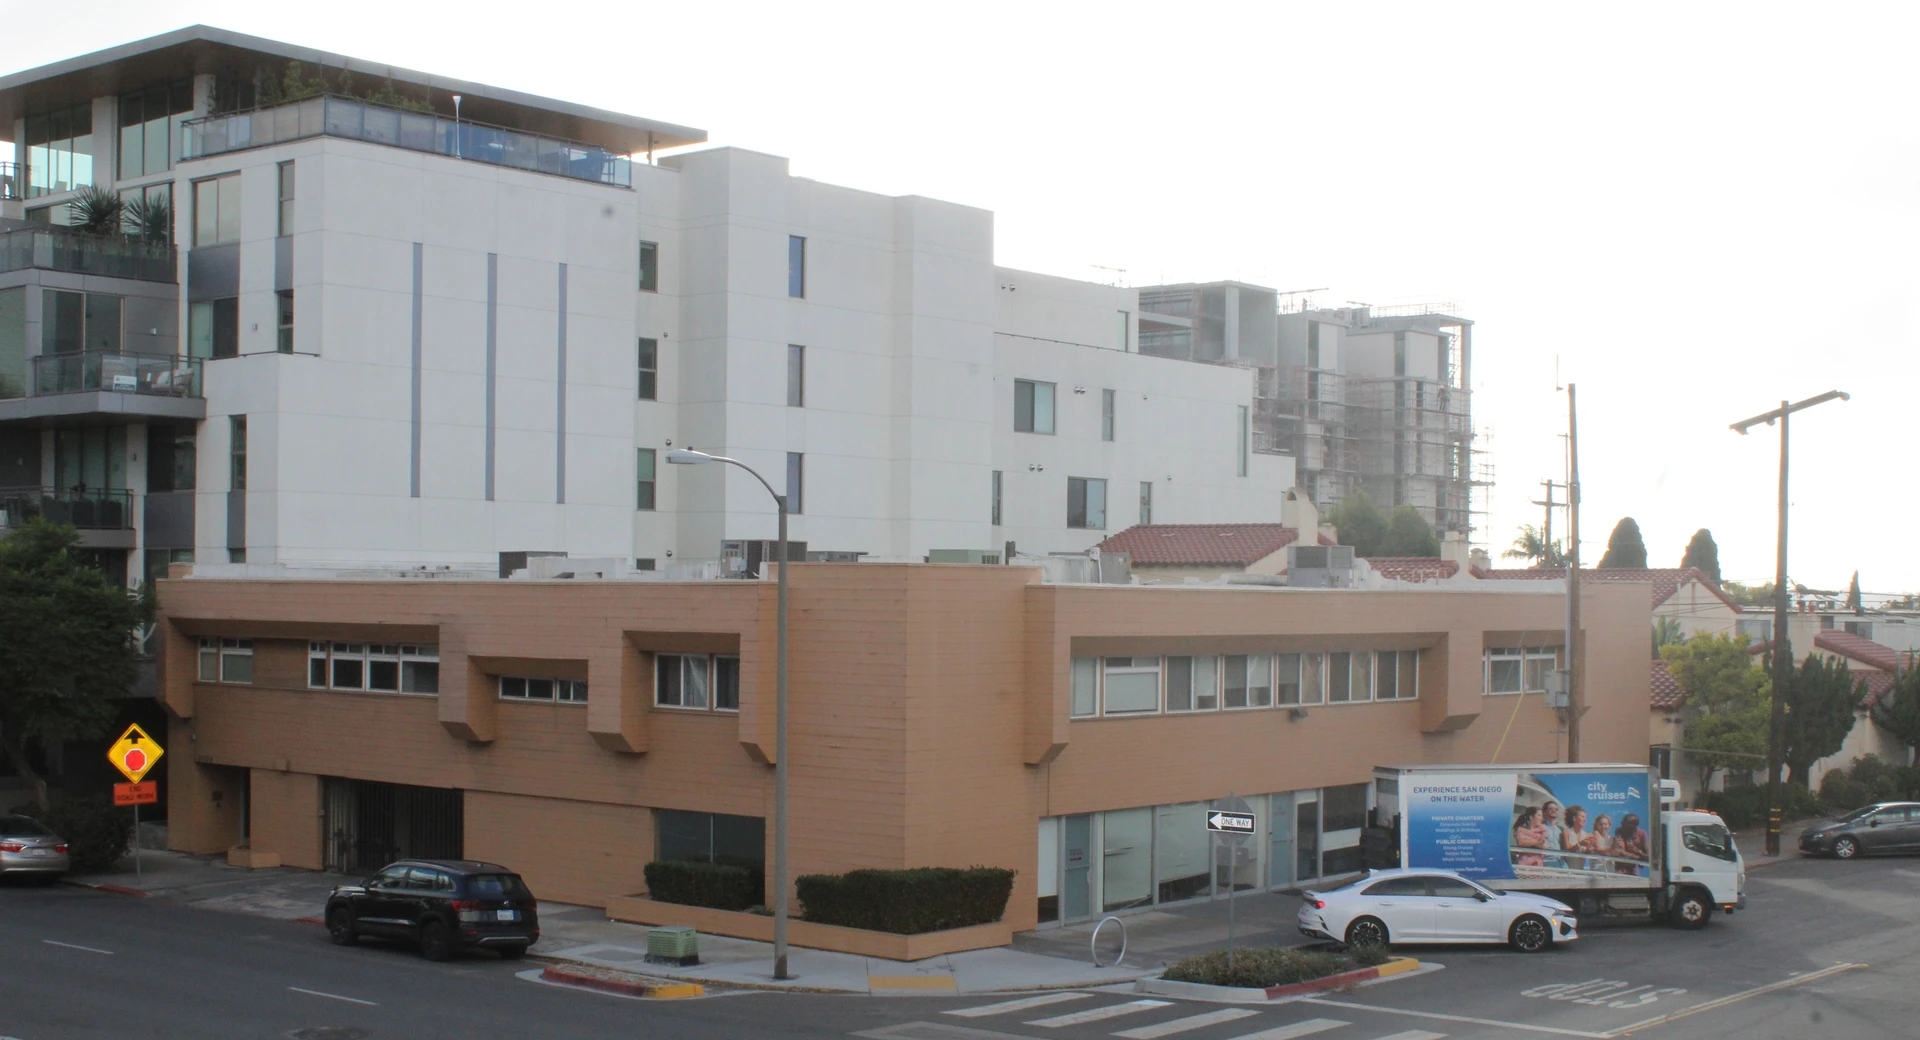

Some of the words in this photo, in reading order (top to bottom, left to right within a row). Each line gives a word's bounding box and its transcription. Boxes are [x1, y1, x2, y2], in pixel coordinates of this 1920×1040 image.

[1479, 785, 1502, 793] DIEGO
[1587, 781, 1607, 792] city
[136, 792, 155, 800] WORK
[1430, 795, 1441, 803] ON
[1587, 791, 1626, 800] cruises
[1221, 817, 1235, 826] ONE
[1236, 818, 1250, 827] WAY
[1519, 978, 1688, 1009] STOP
